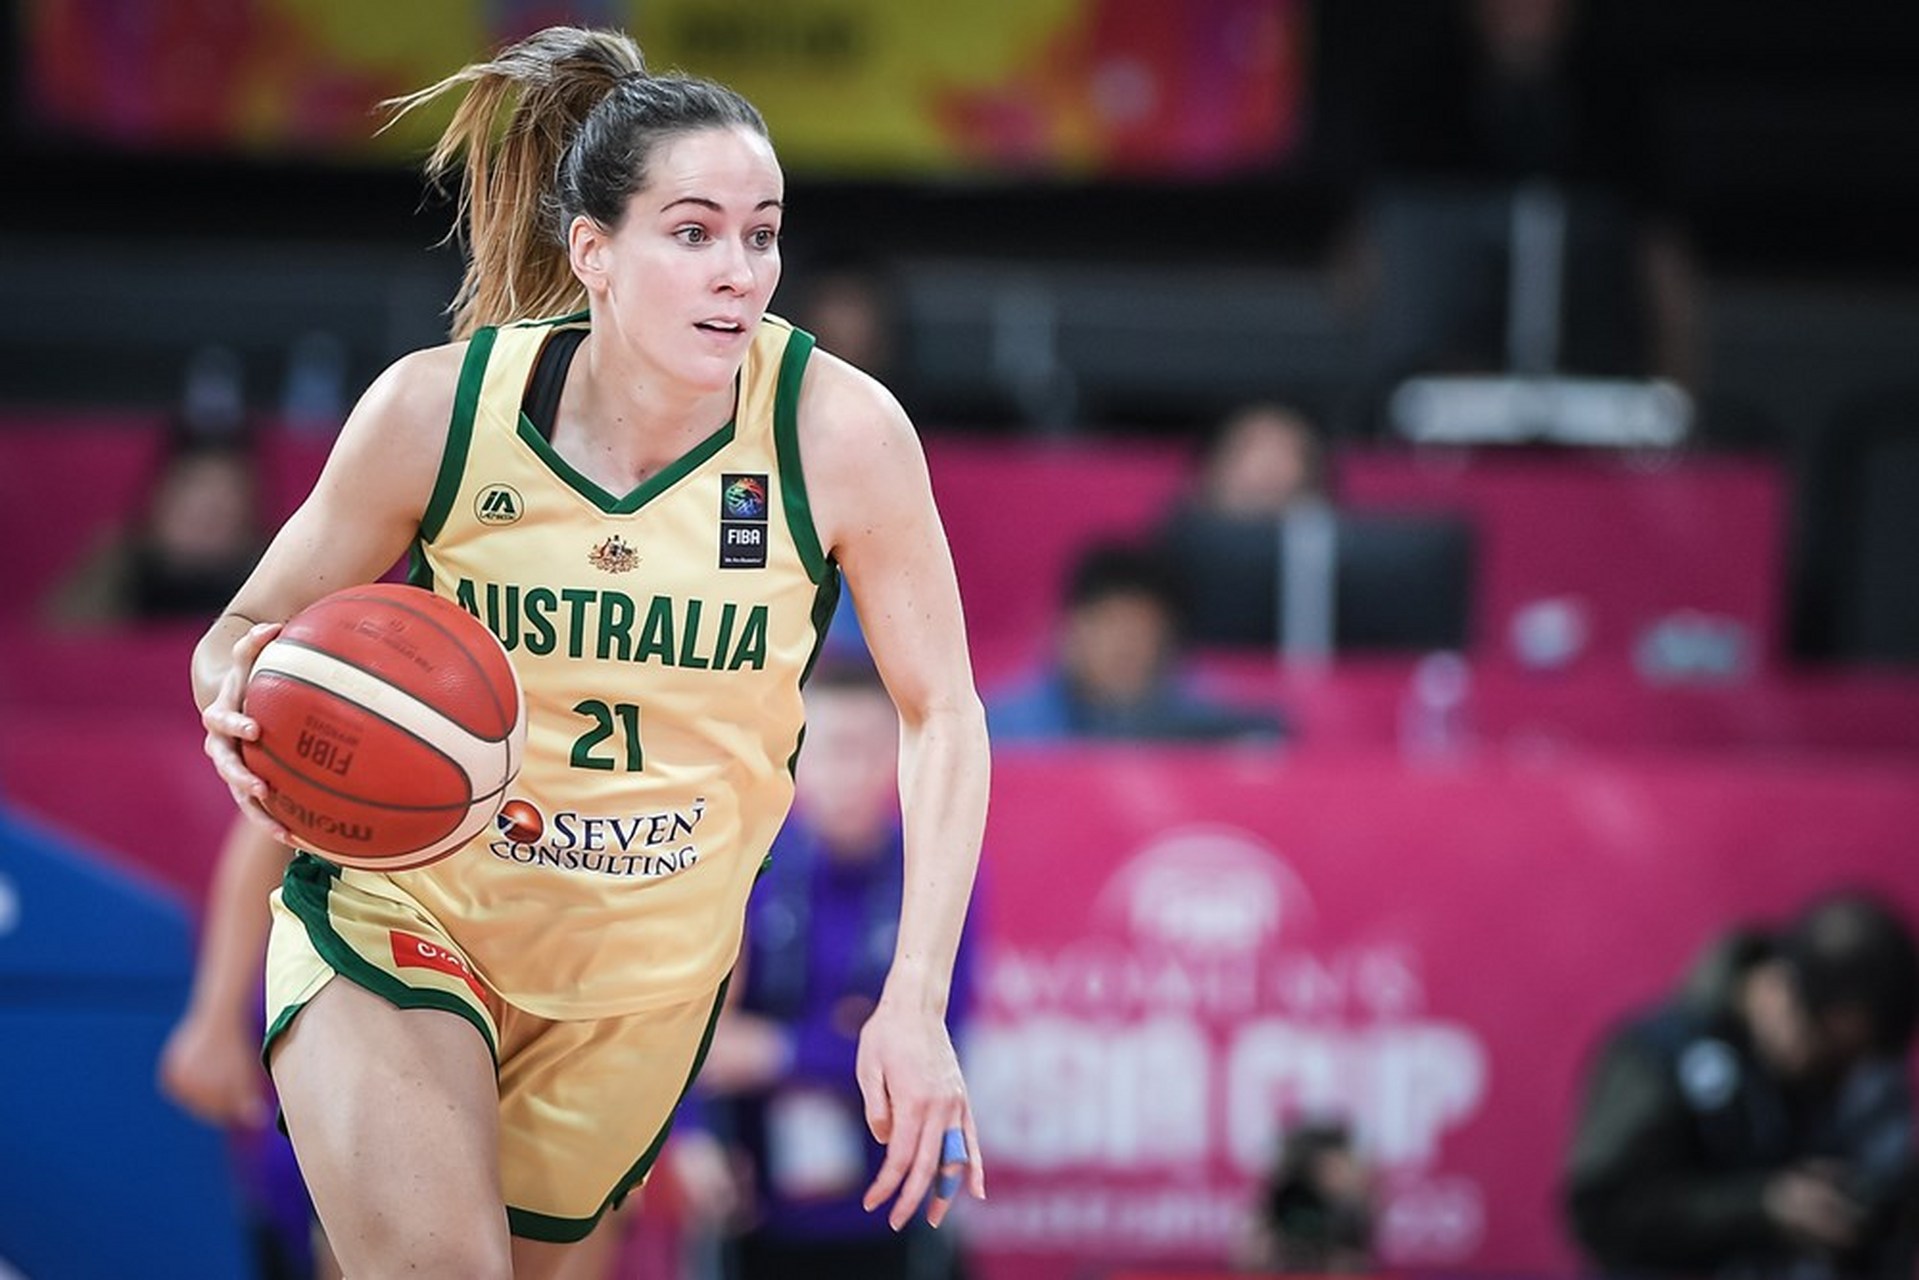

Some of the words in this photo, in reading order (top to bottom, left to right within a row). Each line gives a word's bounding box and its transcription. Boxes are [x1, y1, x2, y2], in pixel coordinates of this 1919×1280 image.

[727, 528, 761, 545] FIBA
[297, 730, 354, 776] FIBA
[569, 699, 644, 772] 21
[551, 807, 704, 852] SEVEN
[489, 840, 698, 876] CONSULTING
